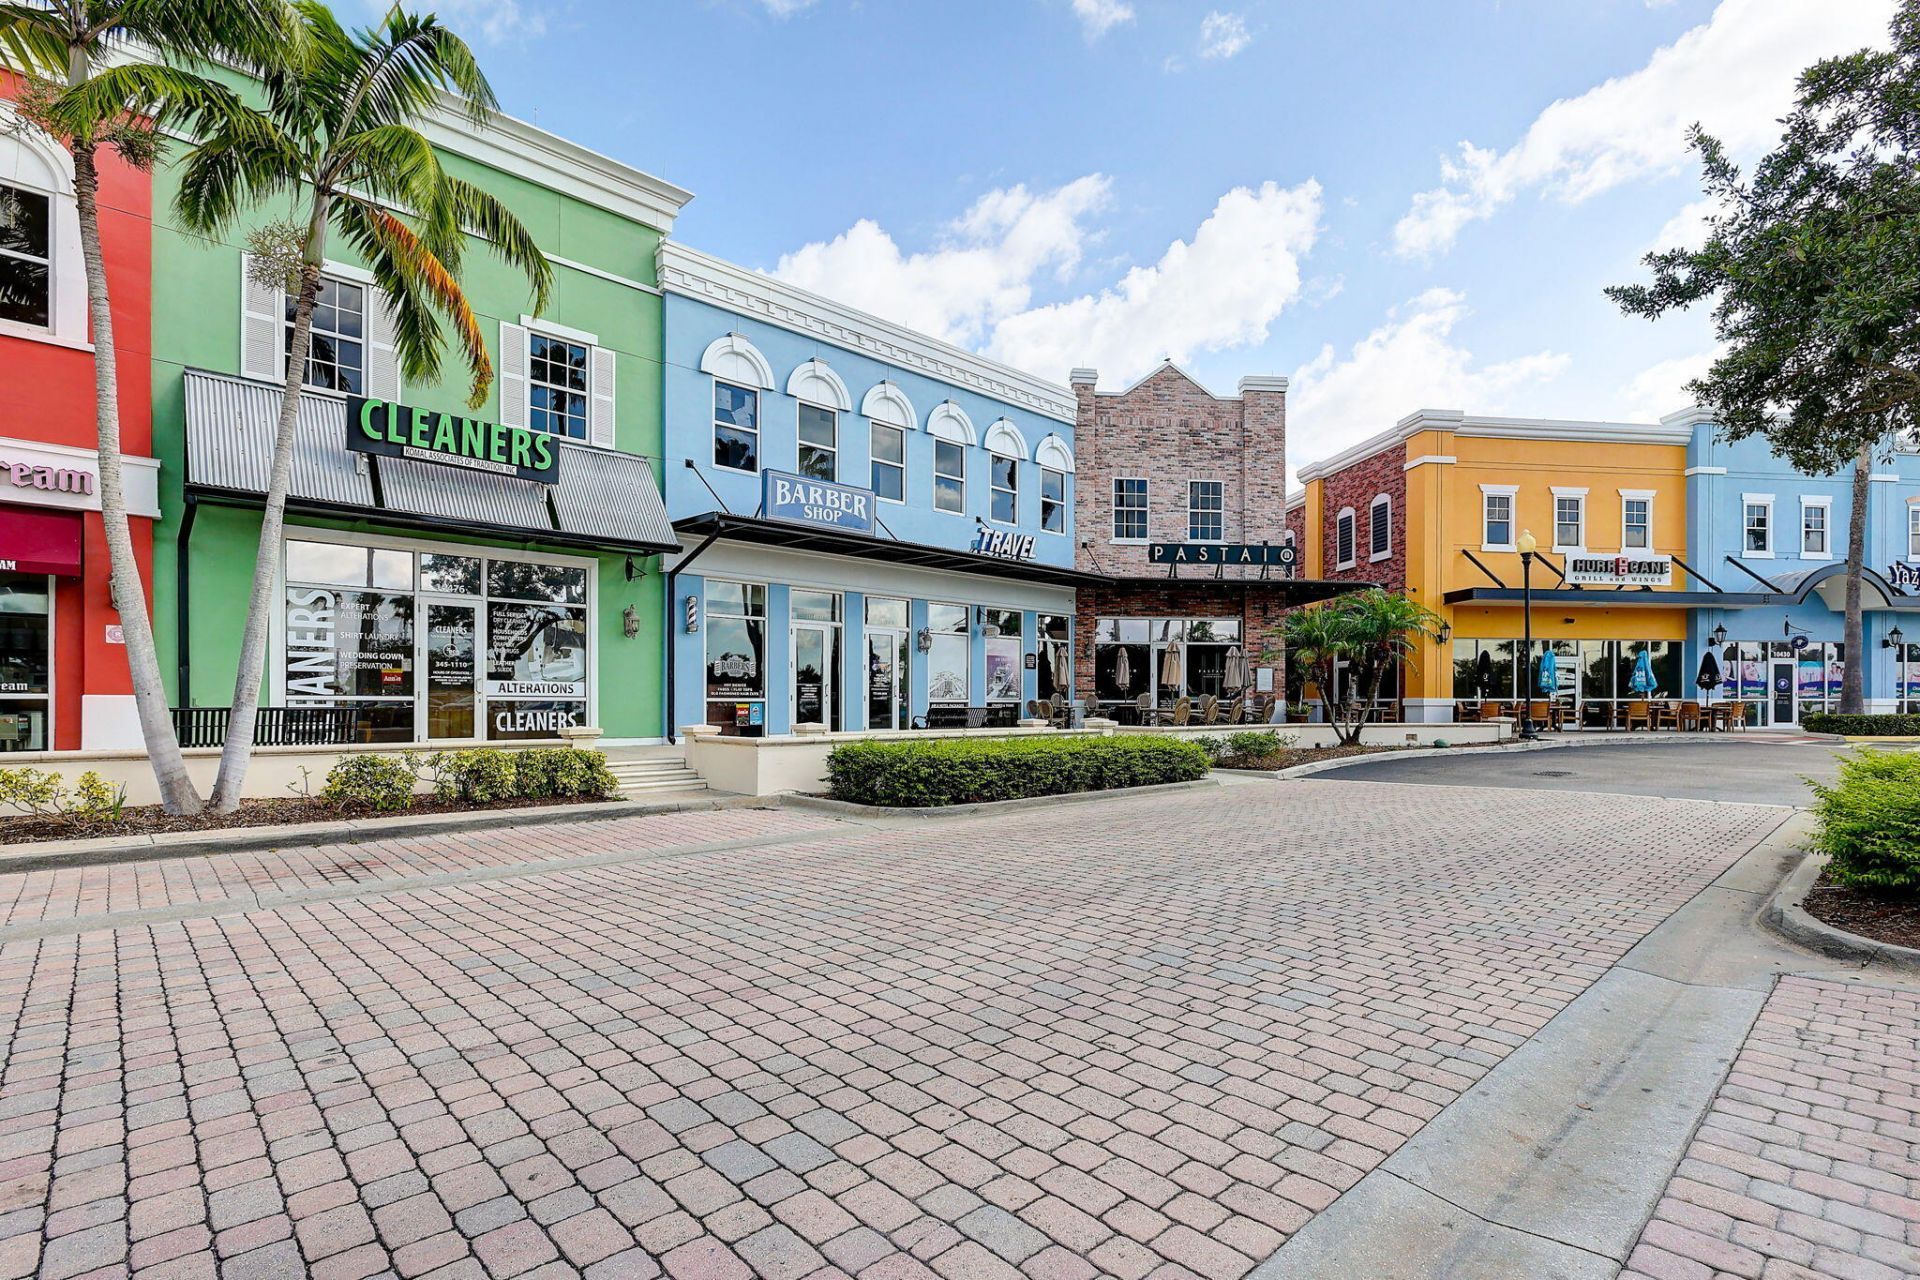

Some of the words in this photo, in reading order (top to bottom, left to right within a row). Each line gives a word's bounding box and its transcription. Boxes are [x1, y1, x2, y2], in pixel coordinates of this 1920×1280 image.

[361, 398, 552, 470] CLEANERS
[405, 447, 427, 459] KOMAL
[429, 451, 463, 465] ASSOCIATES
[464, 458, 473, 467] OF
[474, 459, 504, 472] TRADITION
[505, 465, 515, 474] INC
[775, 479, 867, 521] BARBER
[803, 504, 843, 523] SHOP
[979, 527, 1037, 559] TRAVEL
[1154, 546, 1294, 563] PASTAIO
[340, 602, 370, 611] EXPERT
[340, 612, 389, 622] ALTERATIONS
[493, 610, 506, 618] FULL
[506, 611, 528, 619] SERVICE
[435, 625, 468, 635] CLEANERS
[340, 631, 363, 640] SHIRT
[364, 632, 399, 641] LAUNDRY
[340, 651, 379, 660] WEDDING
[380, 652, 404, 661] GOWN
[340, 661, 393, 671] PRESERVATION
[435, 660, 468, 668] 345-1110
[493, 660, 515, 668] LEATHER
[498, 682, 574, 694] ALTERATIONS
[496, 711, 577, 732] CLEANERS
